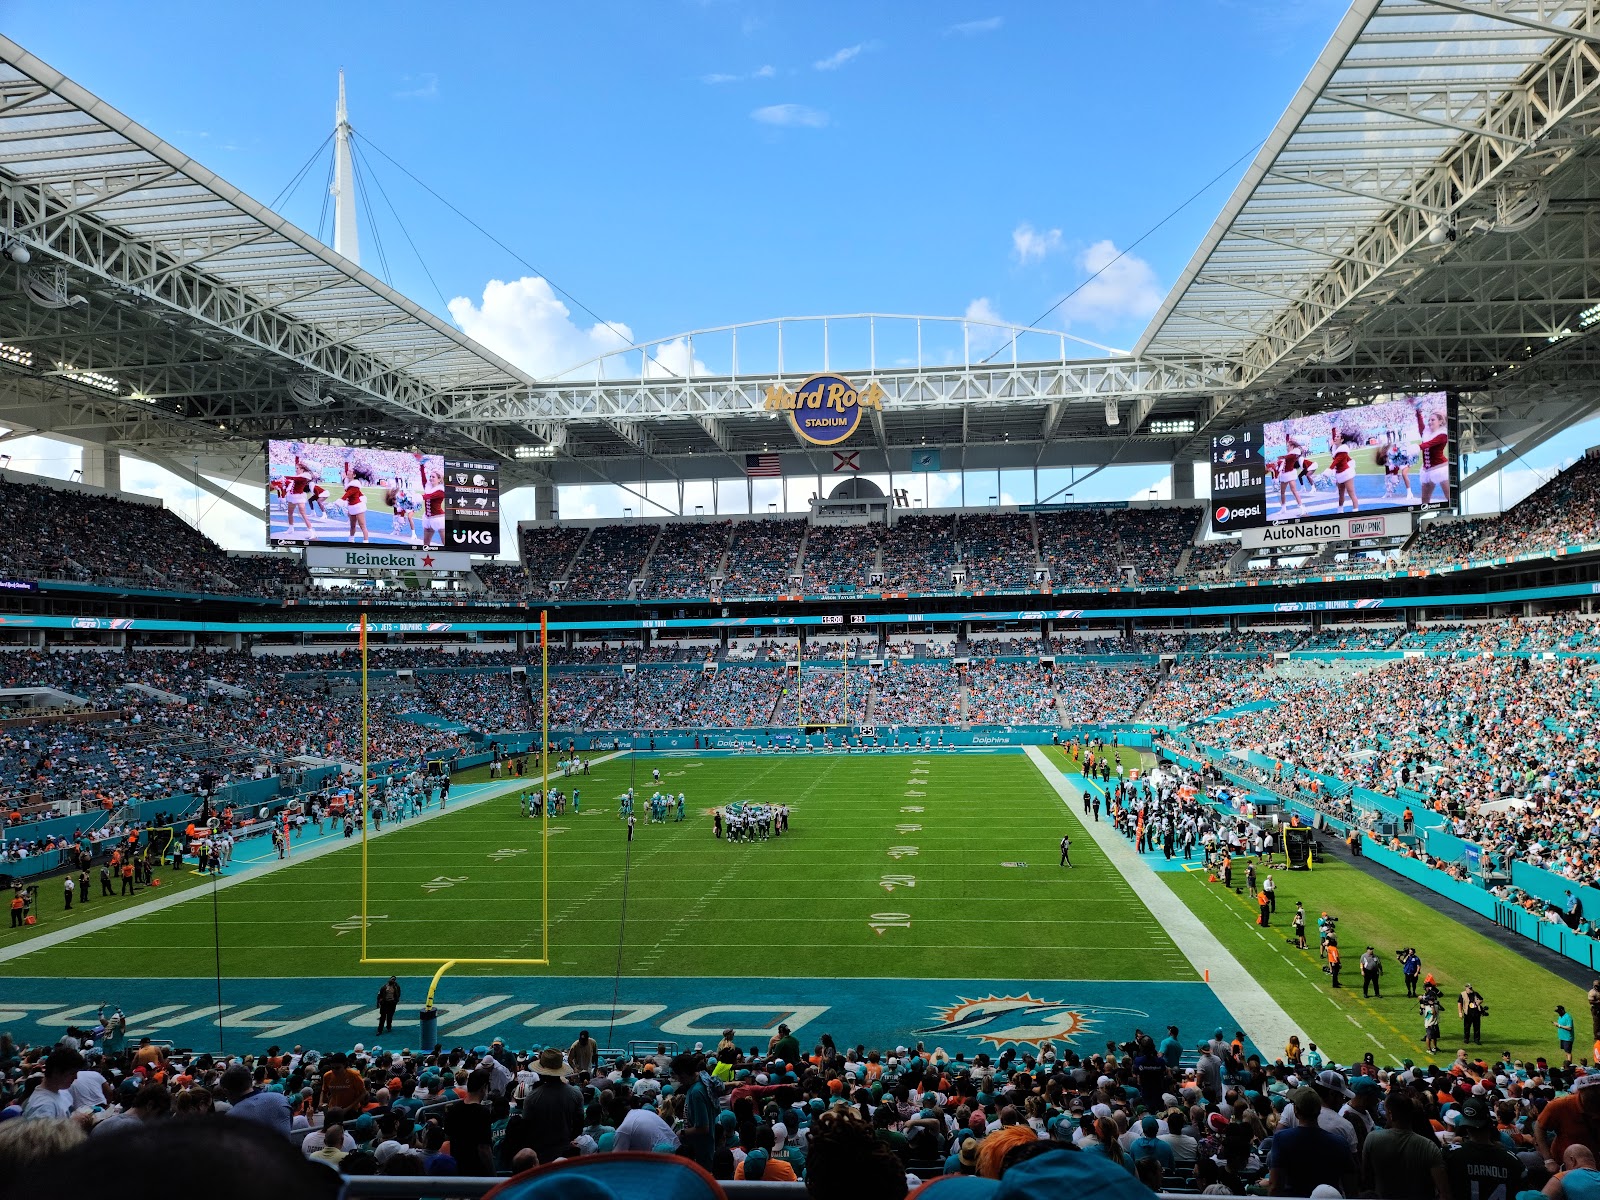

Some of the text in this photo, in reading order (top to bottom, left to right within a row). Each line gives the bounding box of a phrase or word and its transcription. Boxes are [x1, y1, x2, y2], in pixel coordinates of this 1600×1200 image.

[764, 382, 884, 412] Hard Rock
[805, 418, 848, 427] STADIUM
[1244, 432, 1250, 442] 10
[1214, 471, 1240, 490] 15:00
[1231, 505, 1260, 520] pepsi
[1263, 523, 1340, 542] AutoNation
[346, 552, 416, 566] Heineken
[1325, 601, 1349, 609] DOLPHINS
[421, 876, 469, 888] 20
[879, 875, 915, 887] 20
[331, 915, 388, 929] 10
[868, 912, 910, 928] 10
[1467, 1164, 1508, 1179] DARNOLD
